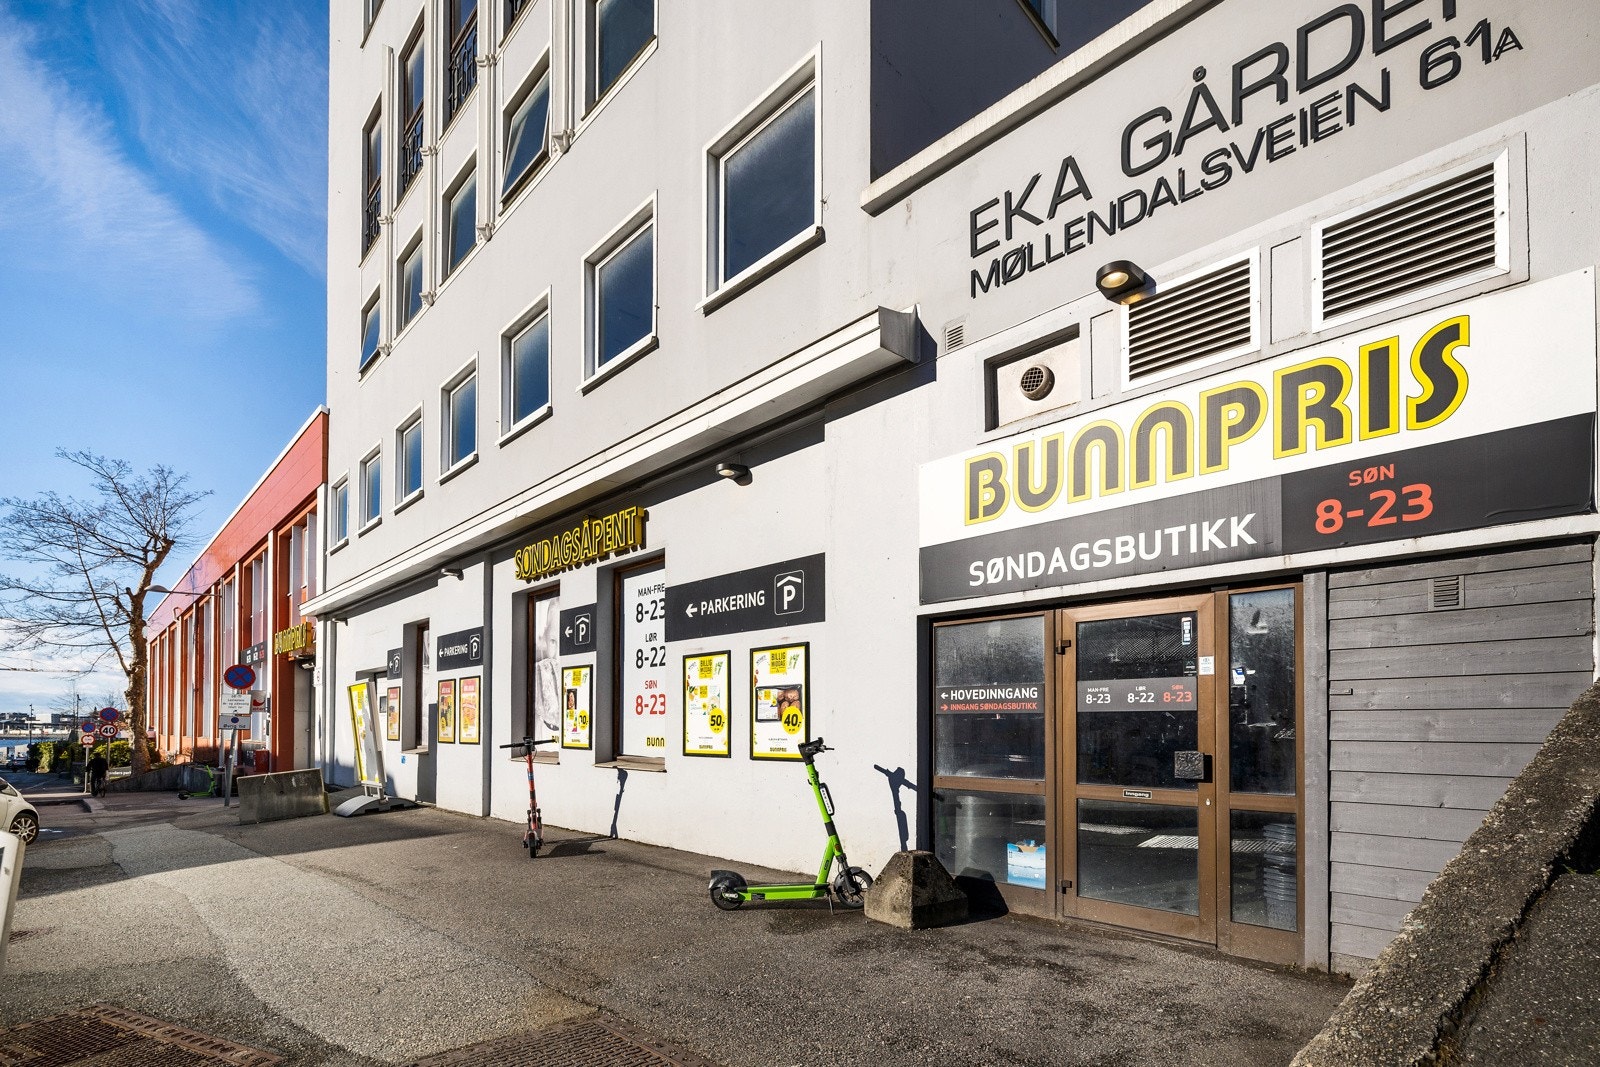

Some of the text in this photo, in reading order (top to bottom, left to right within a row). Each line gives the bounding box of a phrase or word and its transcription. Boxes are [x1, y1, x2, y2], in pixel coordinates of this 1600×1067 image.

[970, 0, 1457, 258] EKA GÅRDE
[970, 68, 1390, 299] MØLLENDALSVEIEN
[964, 315, 1470, 526] BUNNPRIS
[1348, 463, 1395, 487] SØN
[1315, 484, 1433, 534] 8-23
[968, 513, 1257, 587] SØNDAGSBUTIKK
[638, 583, 665, 597] MAN-FRE
[636, 598, 665, 623] 8-23
[700, 590, 765, 616] PARKERING
[645, 633, 657, 642] LØR
[444, 644, 468, 657] PARKERING
[636, 646, 666, 669] 8-22
[645, 680, 657, 690] SØN
[950, 687, 1038, 701] HOVEDINNGANG
[1085, 693, 1111, 704] 8-23
[1127, 692, 1155, 703] 8-22
[1162, 691, 1192, 702] 8-23
[636, 694, 666, 715] 8-23
[950, 702, 1038, 711] INNGANG SØNDAGSBUTIKK
[646, 737, 665, 748] BUNN
